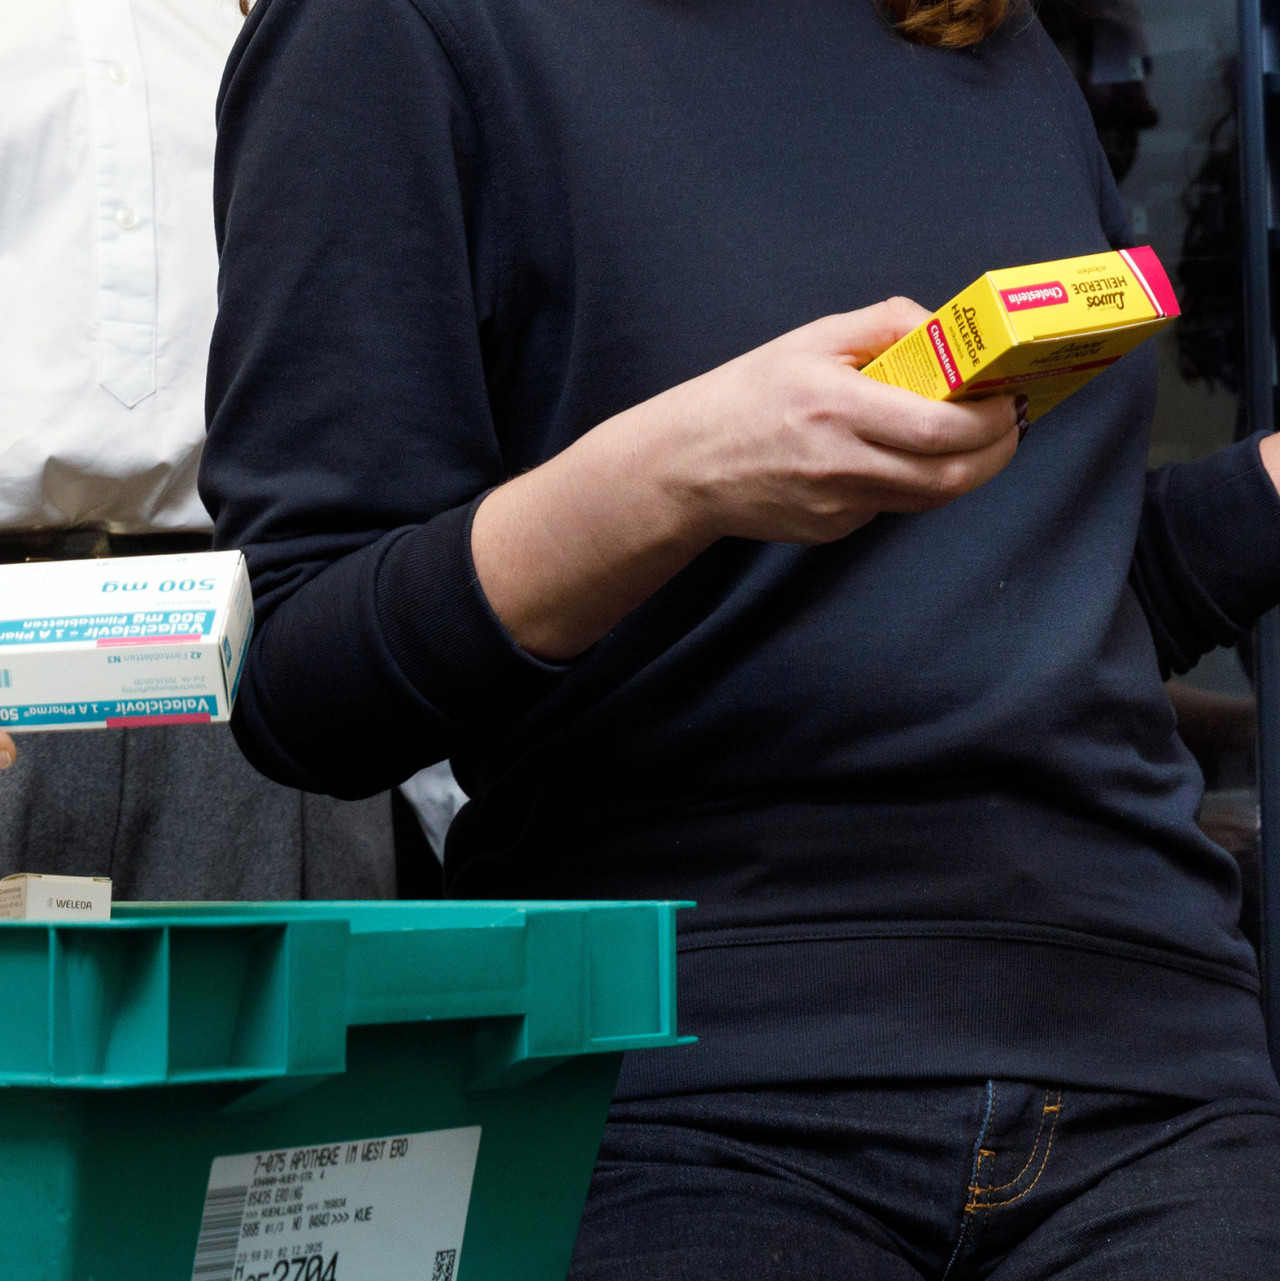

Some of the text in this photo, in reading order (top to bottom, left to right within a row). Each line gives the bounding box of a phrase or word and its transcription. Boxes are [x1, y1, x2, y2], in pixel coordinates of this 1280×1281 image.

[1071, 275, 1128, 295] HEILERDE
[1007, 285, 1063, 305] Cholesterin
[1086, 291, 1125, 311] Luvos
[951, 303, 981, 368] HEILERDE
[962, 306, 987, 352] Luvos
[929, 324, 957, 384] Cholesterin
[101, 578, 217, 593] 500 mg
[23, 612, 207, 629] 500 mg Filmtabletten
[39, 630, 51, 639] A
[55, 629, 65, 638] 1
[84, 623, 204, 638] Valaciclovir
[107, 651, 202, 664] 42 Filmtabletten N3
[121, 684, 207, 694] Verschreibungspflichtig
[78, 704, 88, 713] A
[91, 703, 99, 713] 1
[115, 698, 210, 715] Valaciclovir
[56, 898, 93, 910] WELEDA
[290, 1146, 341, 1170] APOTHEKE
[345, 1143, 359, 1164] IM
[361, 1140, 387, 1163] WEST
[389, 1137, 410, 1159] ERD
